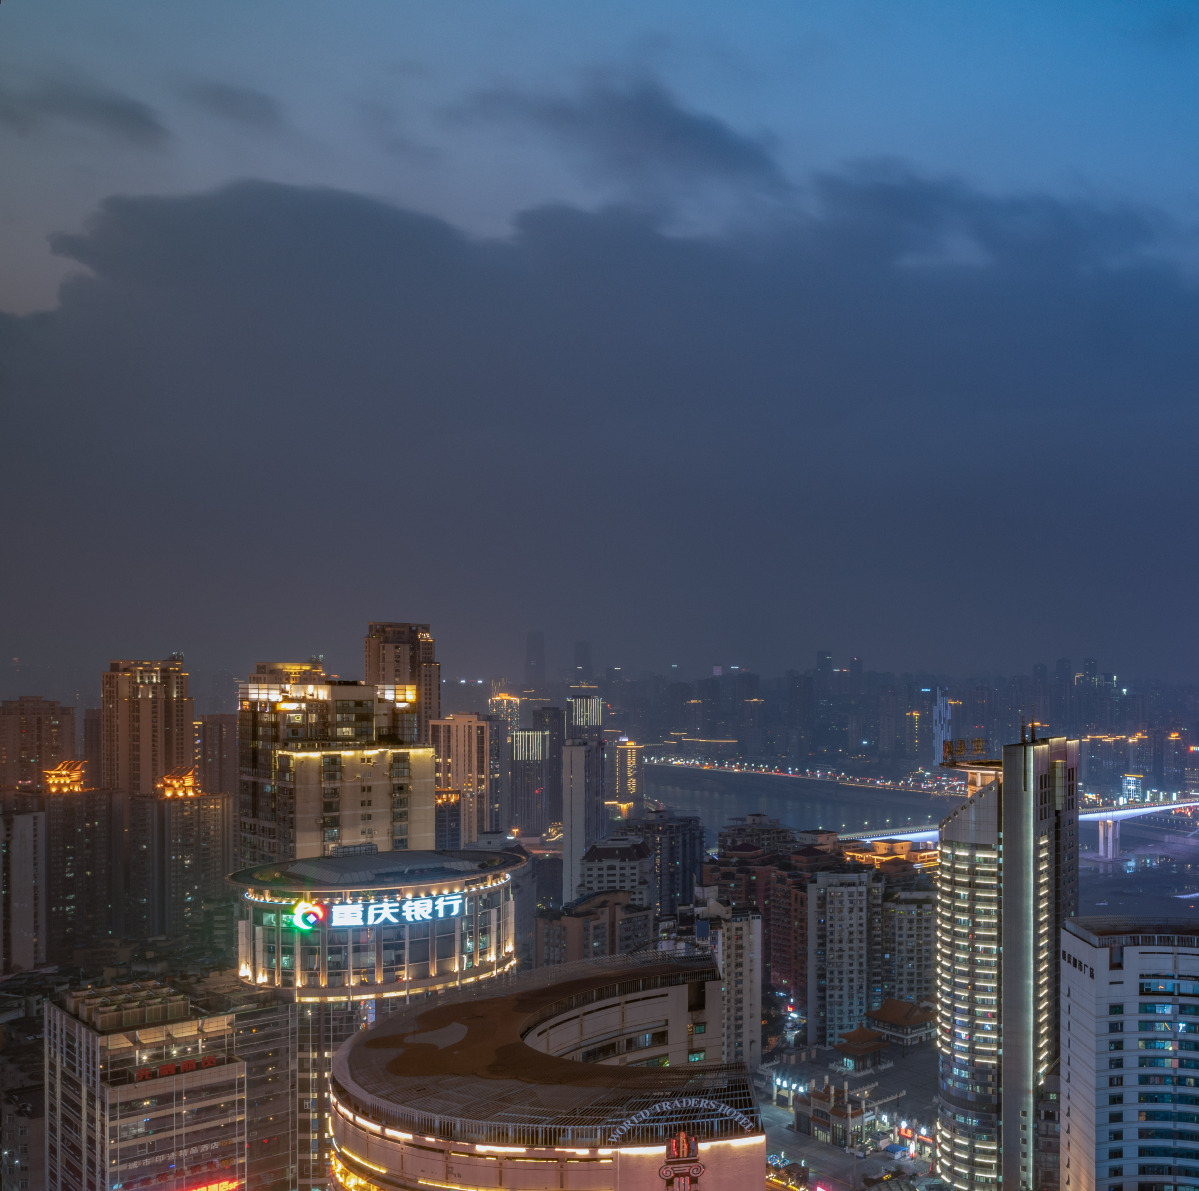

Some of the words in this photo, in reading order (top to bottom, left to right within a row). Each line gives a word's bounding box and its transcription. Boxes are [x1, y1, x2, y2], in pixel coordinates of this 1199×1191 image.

[332, 895, 463, 926] 重庆银行
[652, 1098, 716, 1114] TRADERS
[717, 1103, 755, 1132] HOTEL
